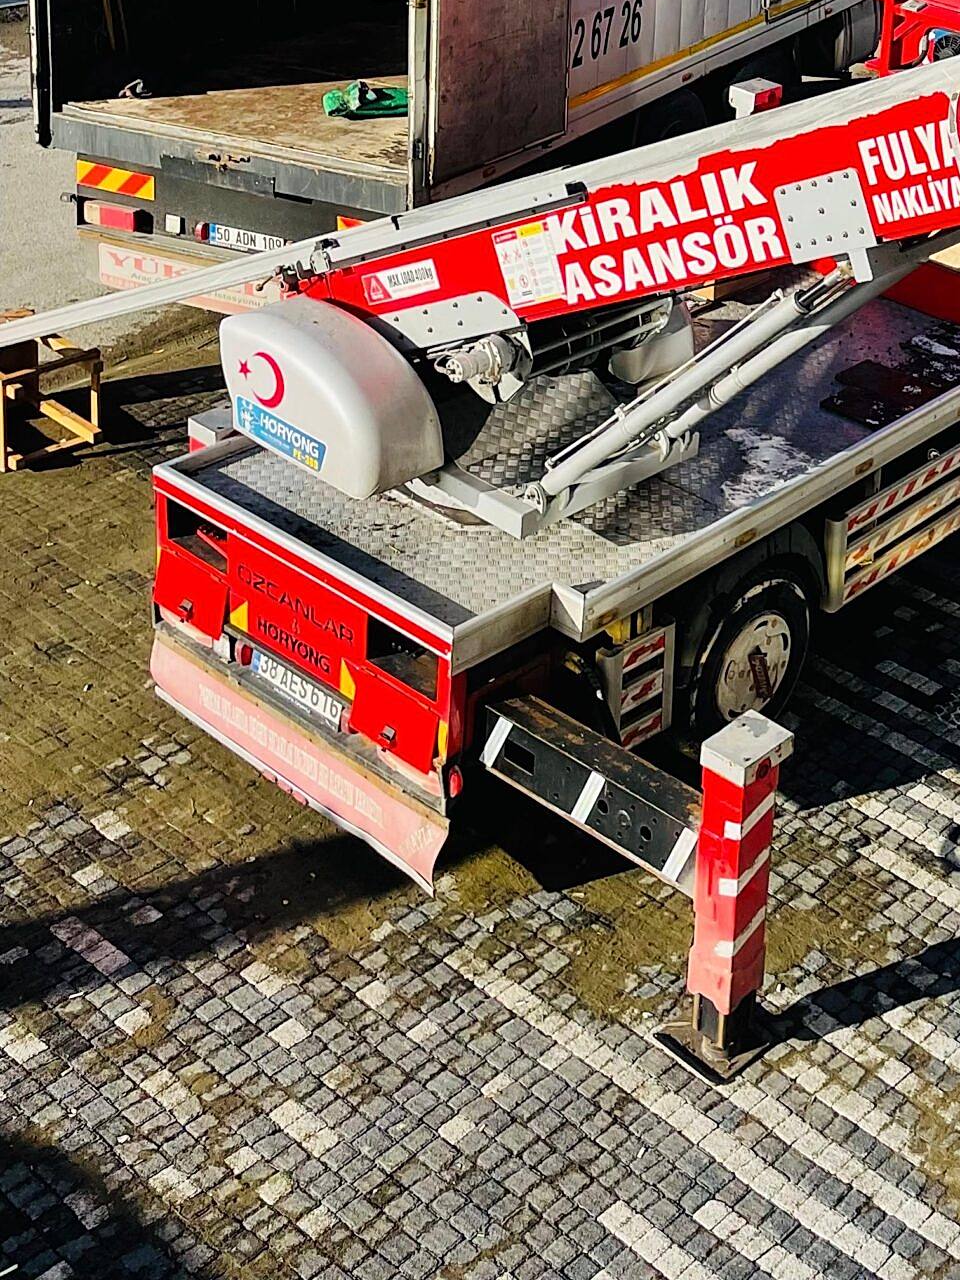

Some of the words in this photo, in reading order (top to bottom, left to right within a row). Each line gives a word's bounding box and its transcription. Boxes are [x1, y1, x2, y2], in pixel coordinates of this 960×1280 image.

[591, 6, 616, 60] 67
[858, 118, 957, 186] FULYA
[548, 161, 768, 255] KİRALIK
[217, 228, 230, 242] 50
[236, 231, 257, 248] ADN
[564, 215, 785, 305] ASANSÖR
[260, 412, 319, 459] HORYONG
[257, 617, 331, 674] HORYONG
[260, 657, 278, 679] 38
